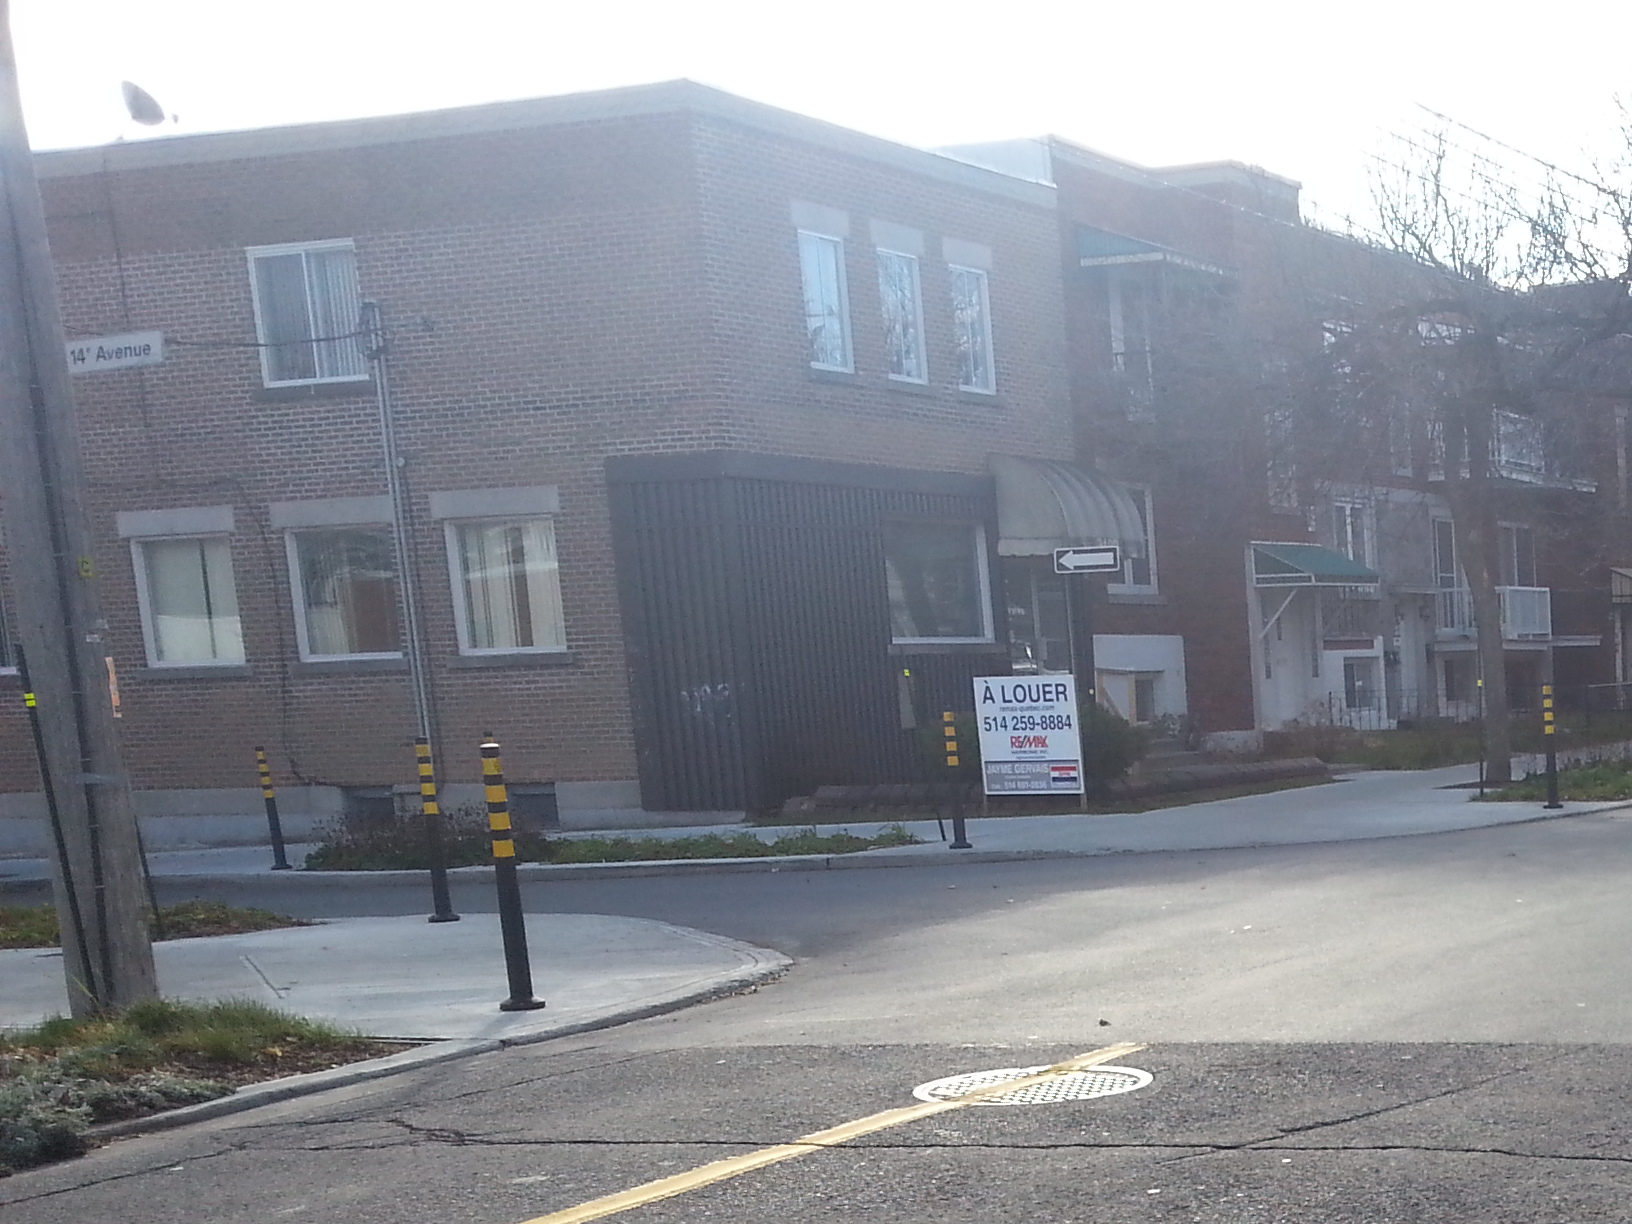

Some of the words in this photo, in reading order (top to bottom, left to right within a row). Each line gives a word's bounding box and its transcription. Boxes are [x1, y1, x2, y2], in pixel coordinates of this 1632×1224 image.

[96, 343, 151, 362] Avenue
[983, 680, 996, 704] À
[1001, 683, 1068, 704] LOUER
[984, 716, 1008, 732] 514
[1011, 714, 1072, 731] 259-8884
[1010, 735, 1049, 749] RE/MAX
